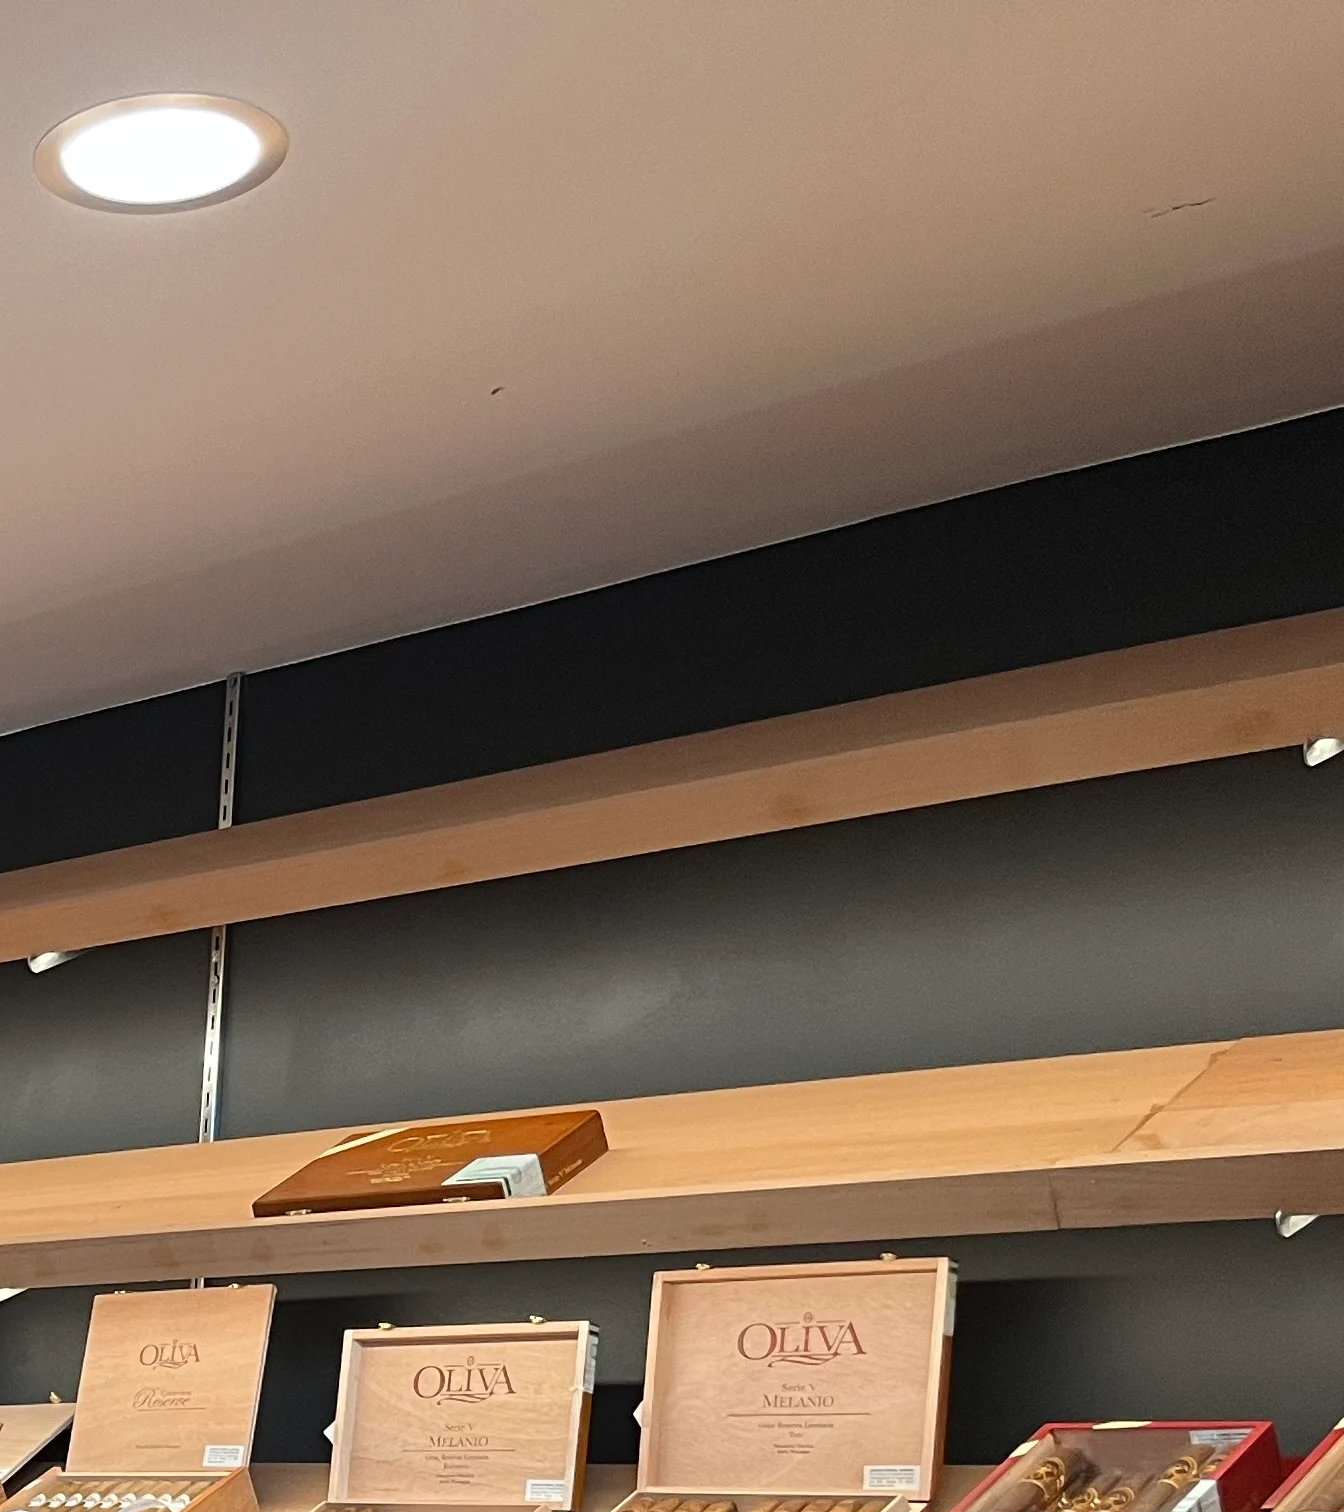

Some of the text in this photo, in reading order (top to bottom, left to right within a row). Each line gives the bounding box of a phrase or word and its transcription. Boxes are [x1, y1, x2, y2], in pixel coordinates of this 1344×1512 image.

[737, 1312, 867, 1367] OLIVA
[139, 1340, 200, 1370] OLIVA
[413, 1356, 516, 1405] OLIVA
[763, 1395, 835, 1408] MELANIO
[429, 1436, 489, 1448] MELANIO
